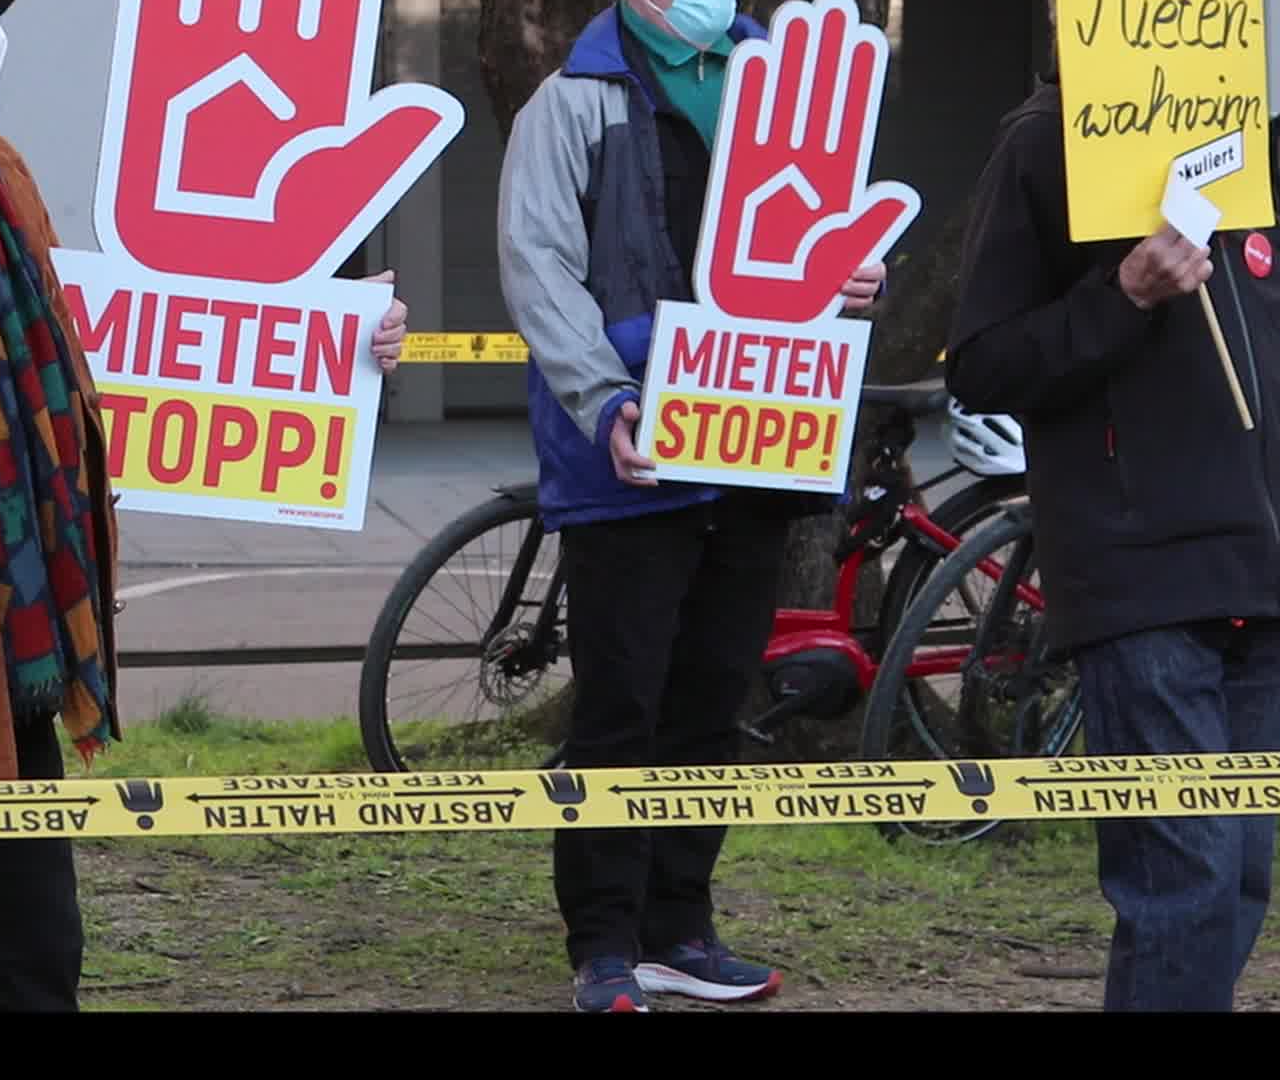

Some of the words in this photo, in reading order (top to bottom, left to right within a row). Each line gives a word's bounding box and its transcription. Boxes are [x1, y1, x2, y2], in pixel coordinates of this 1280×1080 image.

[1177, 145, 1235, 182] kuliert
[63, 283, 361, 397] MIETEN
[667, 326, 850, 400] MIETEN
[97, 392, 346, 500] TOPP!
[655, 398, 838, 471] STOPP!
[404, 773, 485, 786] KEEP
[640, 766, 807, 781] DISTANCE
[817, 763, 895, 778] KEEP
[1048, 759, 1206, 777] DISTANCE
[223, 777, 390, 792] DISTANCE
[359, 802, 514, 825] ABSTAND
[627, 797, 753, 819] HALTEN
[776, 794, 926, 817] ABSTAND
[1034, 789, 1157, 816] HALTEN
[205, 805, 335, 827] HALTEN
